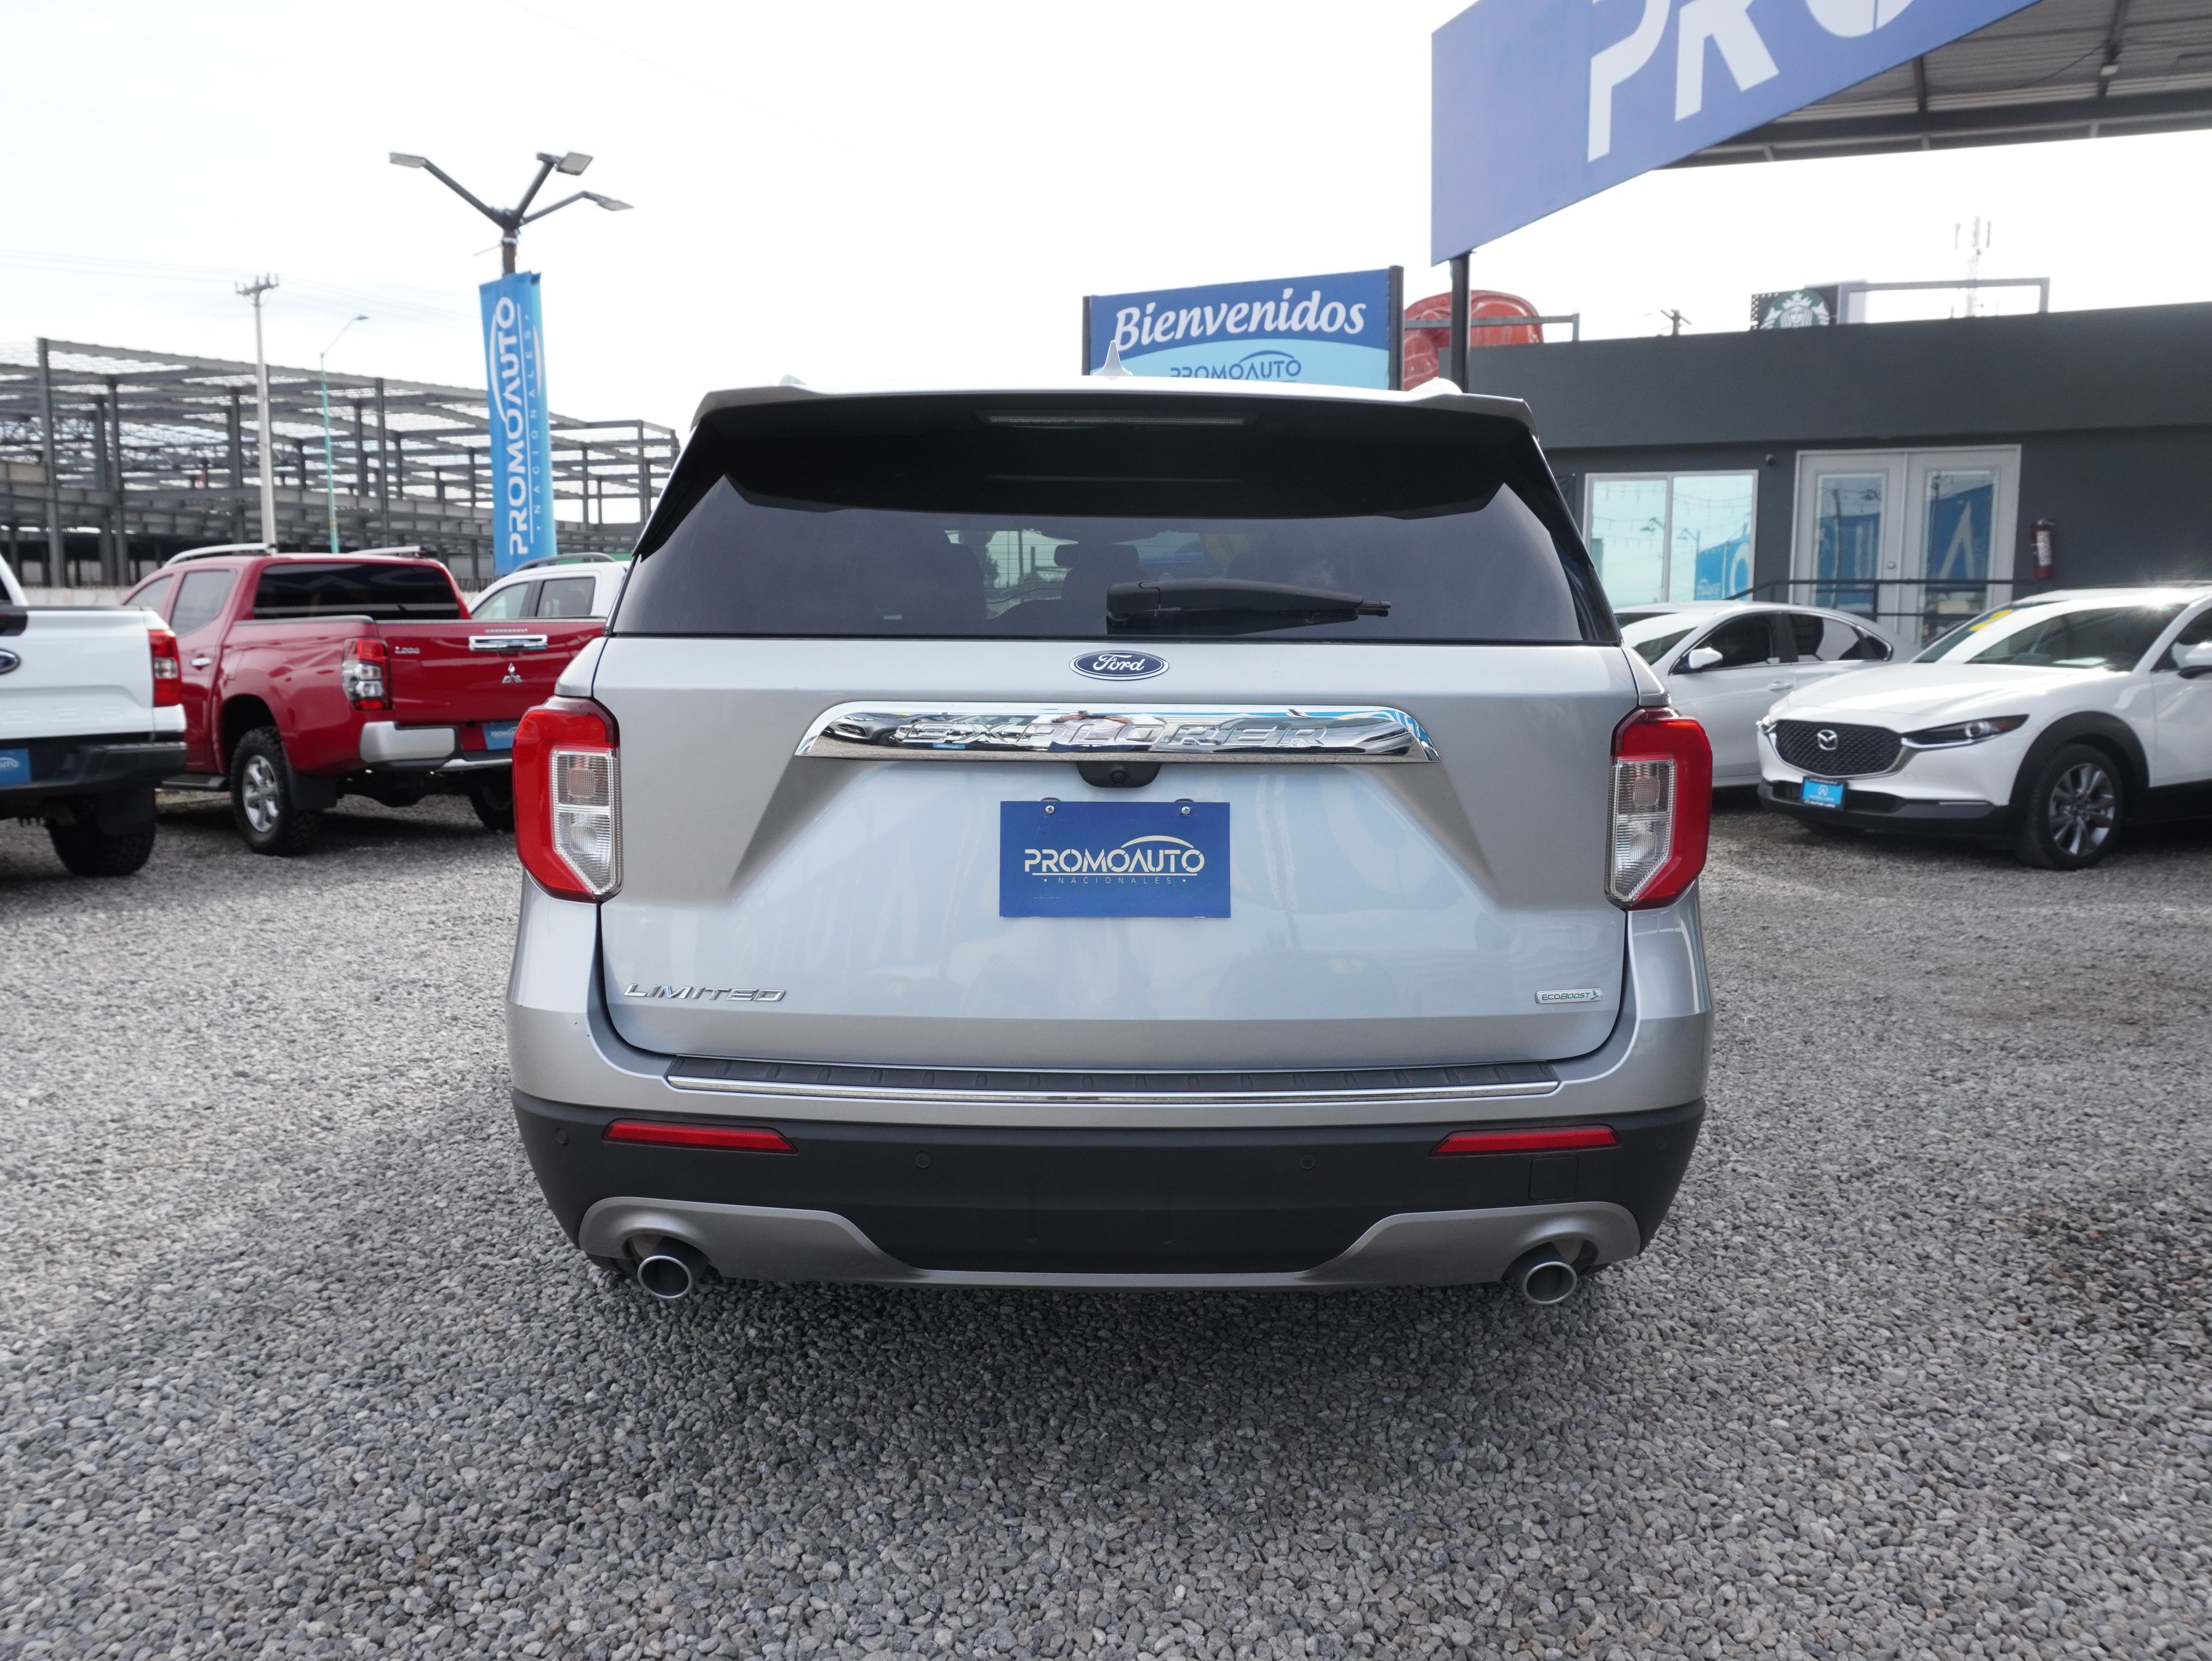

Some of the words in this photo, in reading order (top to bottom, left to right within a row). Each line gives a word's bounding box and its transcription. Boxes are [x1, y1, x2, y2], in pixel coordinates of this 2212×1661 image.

[1587, 0, 1914, 162] PR
[1115, 287, 1366, 351] Bienvenidos
[495, 297, 529, 555] PROMOAUTO
[524, 330, 541, 514] NACIONALES
[1092, 654, 1146, 671] Ford
[903, 721, 1327, 747] EXPLORER
[1024, 848, 1205, 873] PROMOAUTO
[624, 983, 786, 1002] LIMITED
